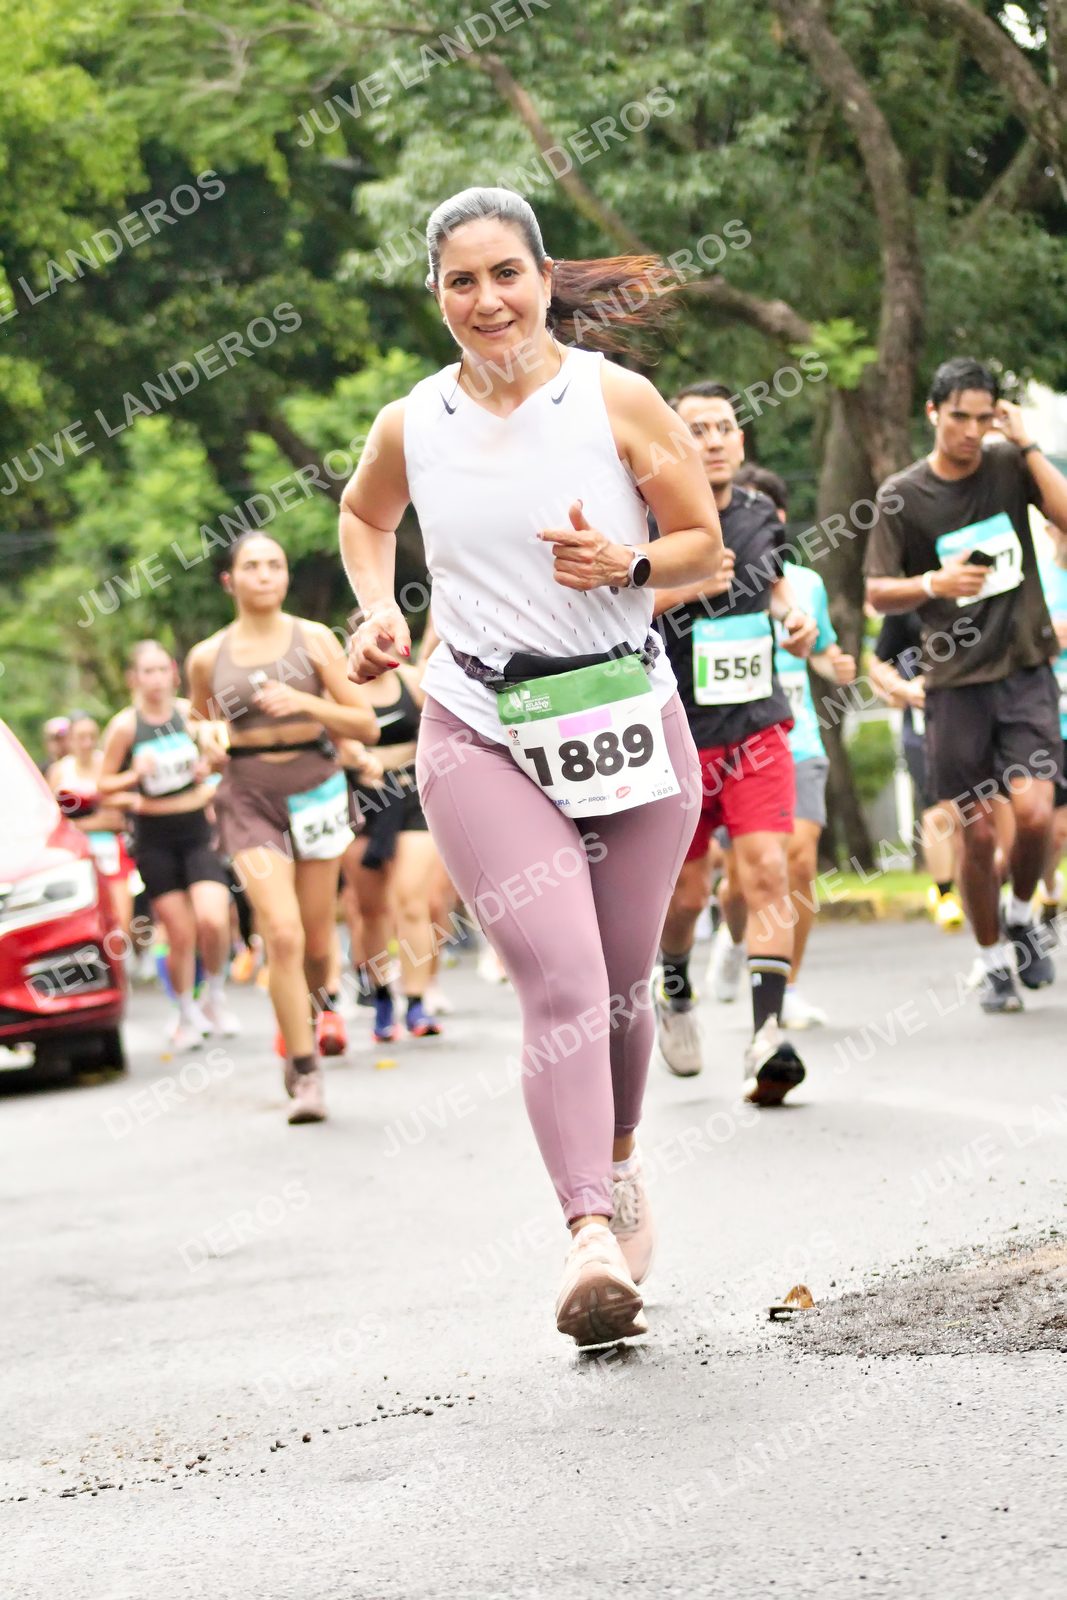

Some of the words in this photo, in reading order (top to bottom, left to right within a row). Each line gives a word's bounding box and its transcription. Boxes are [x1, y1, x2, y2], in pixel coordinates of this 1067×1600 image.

[713, 654, 762, 681] 556
[524, 723, 654, 787] 1889
[651, 786, 674, 799] 1889
